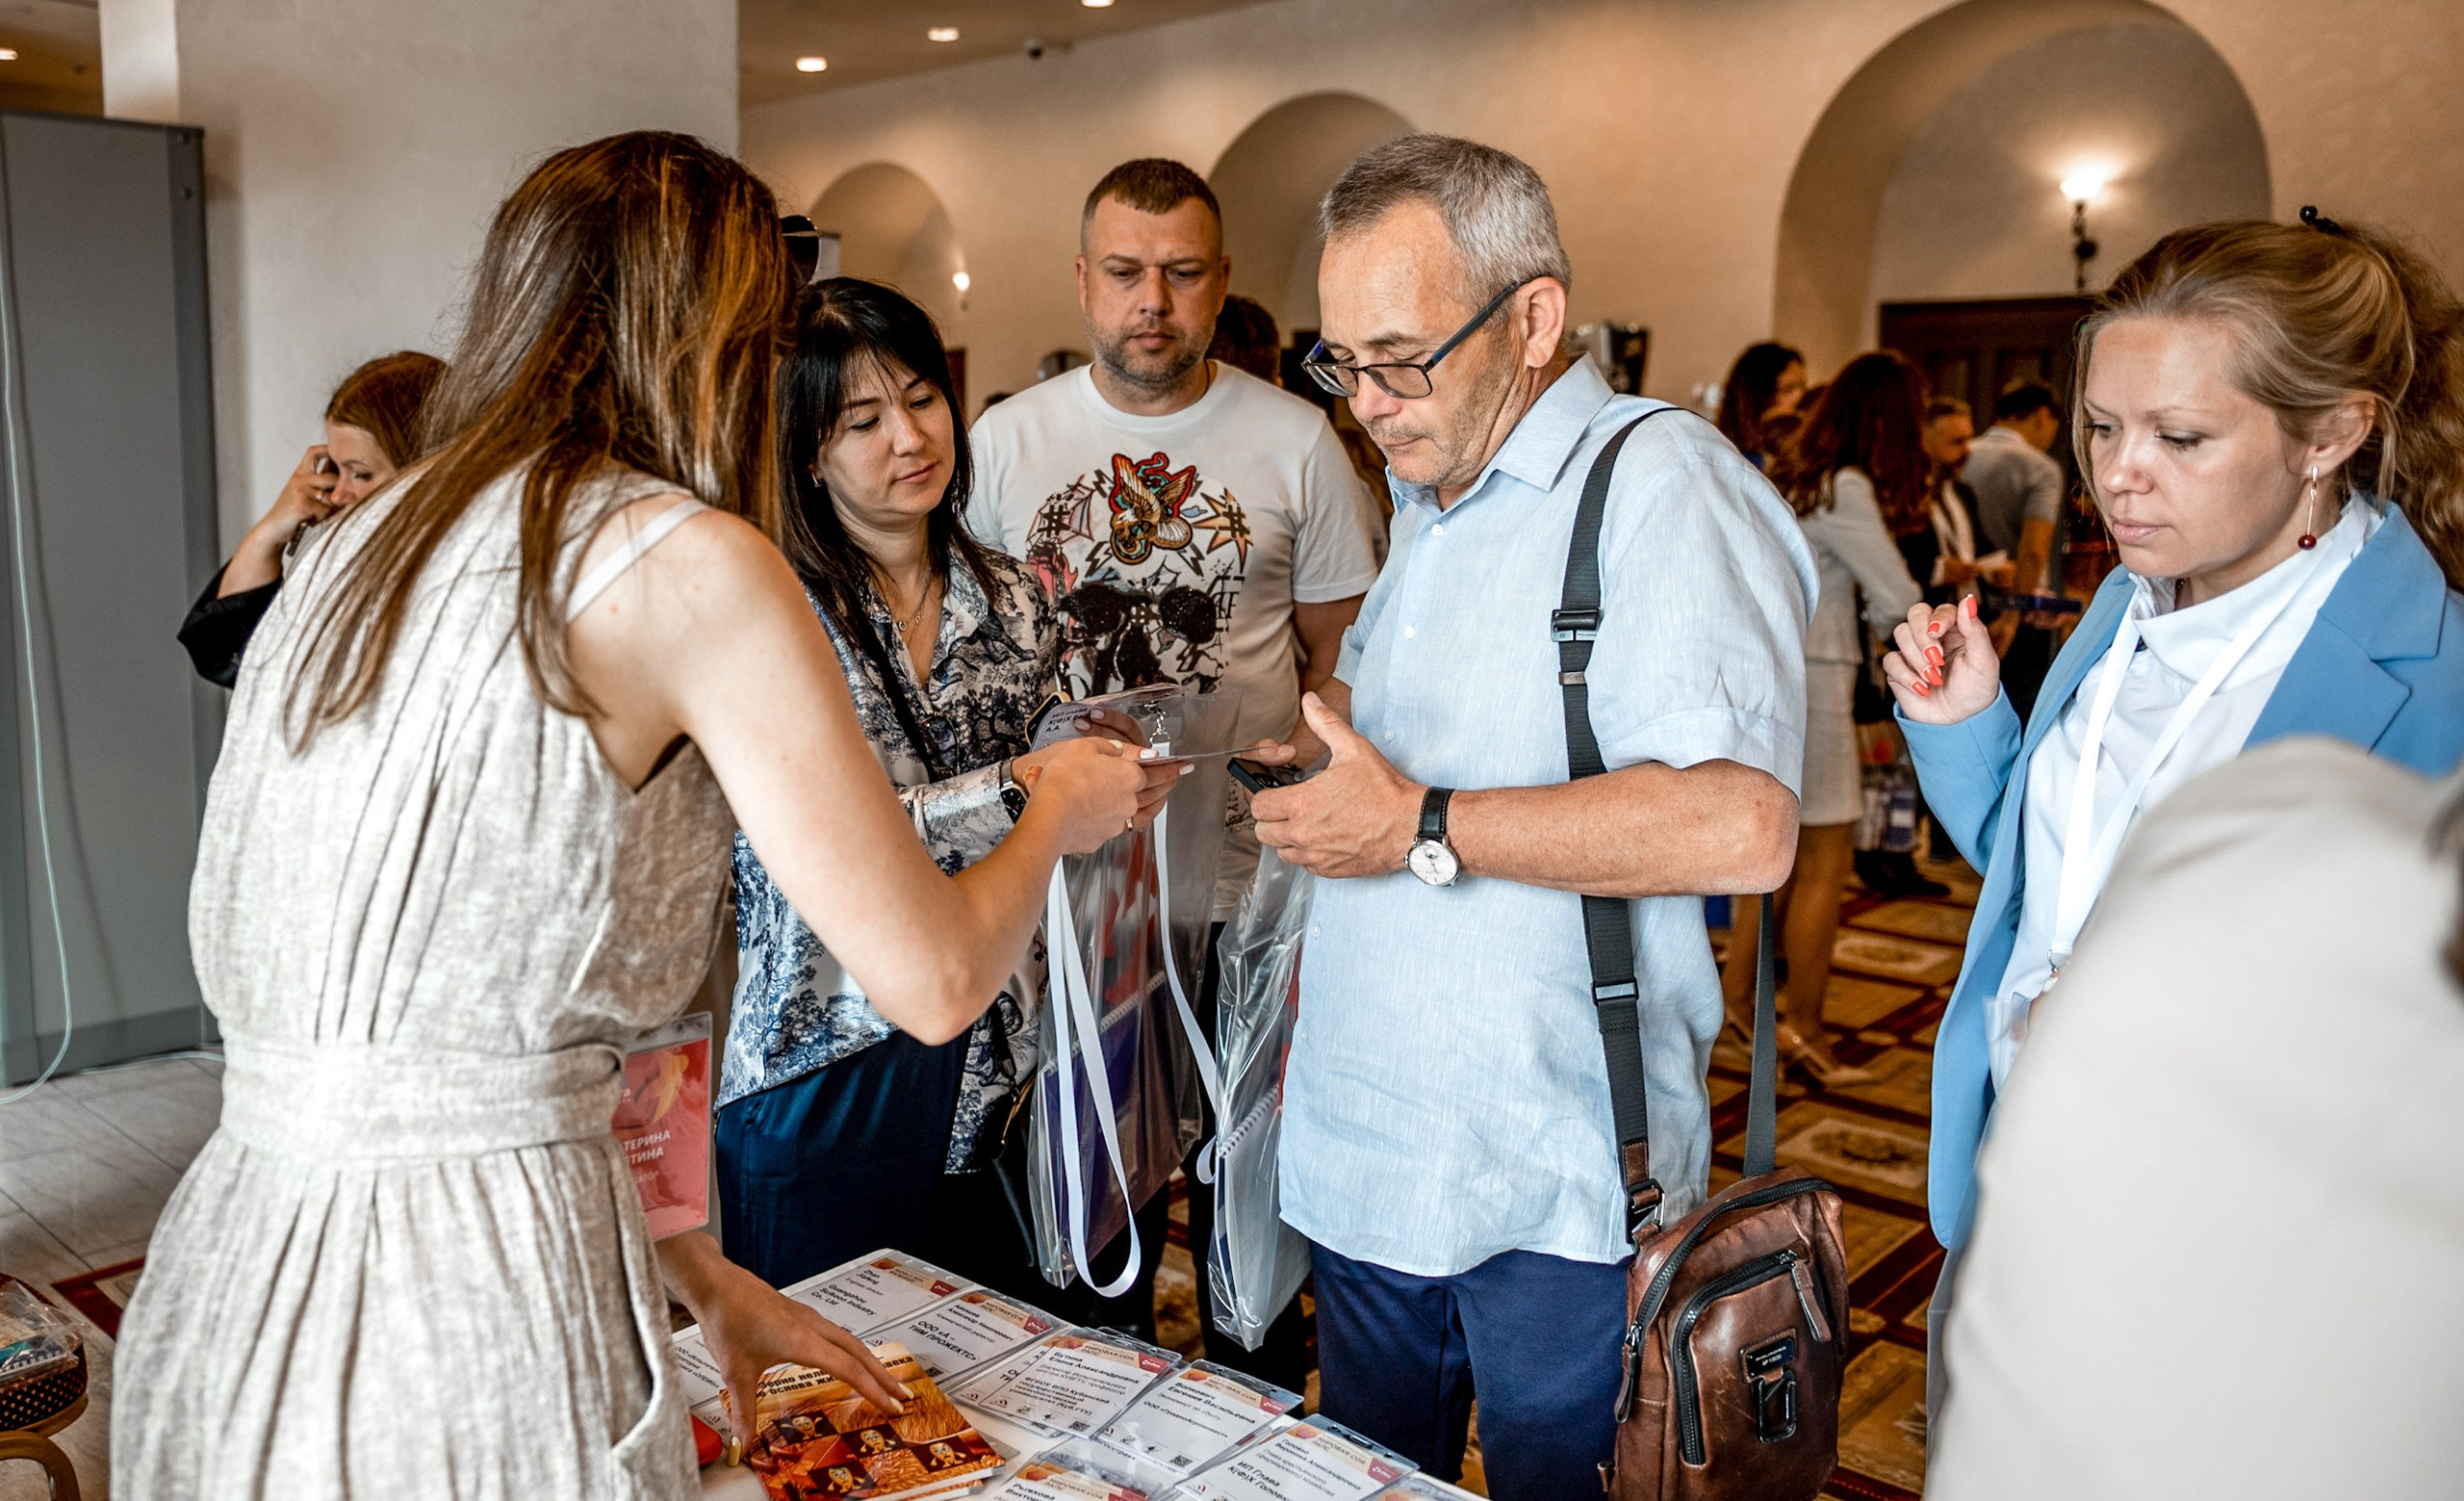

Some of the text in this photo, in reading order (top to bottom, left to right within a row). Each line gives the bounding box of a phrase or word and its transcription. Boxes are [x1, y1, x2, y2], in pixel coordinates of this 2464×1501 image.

[623, 1129, 671, 1152] ТЕРИНА
[829, 1284, 866, 1304] Guangzhou
[847, 1300, 876, 1315] Industry
[909, 1325, 929, 1335] ТИМ
[918, 1321, 939, 1332] ООО
[1049, 1357, 1073, 1366] Елена
[1075, 1363, 1139, 1384] Александровна
[1203, 1400, 1255, 1424] Васильевна
[1238, 1462, 1280, 1487] ИП Глава
